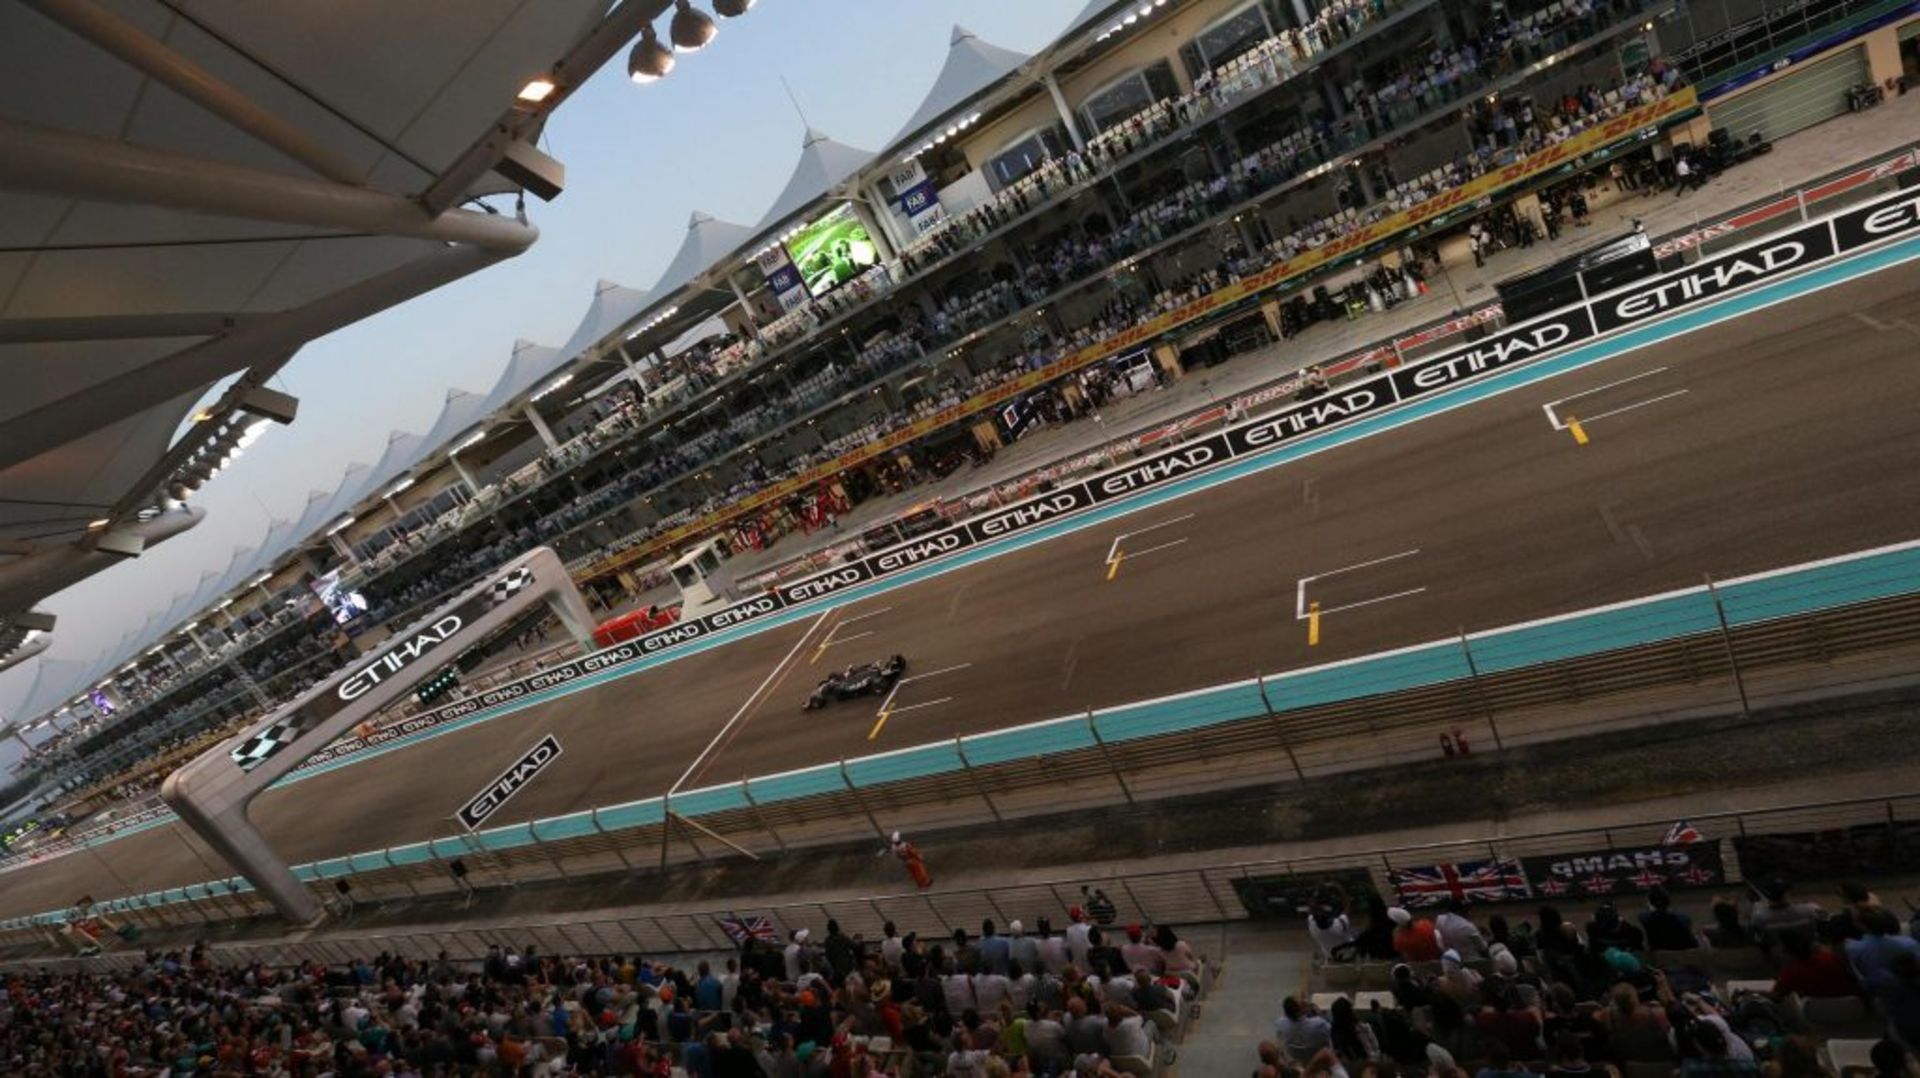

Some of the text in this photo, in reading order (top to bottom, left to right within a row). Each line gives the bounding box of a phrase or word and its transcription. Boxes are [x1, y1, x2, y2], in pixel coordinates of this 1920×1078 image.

[1601, 97, 1682, 140] DHL
[1501, 147, 1569, 184] DHL
[904, 192, 926, 209] FAB
[1407, 190, 1468, 222] DHL
[1322, 227, 1374, 258] DHL
[1241, 265, 1293, 292] DHL
[1616, 241, 1805, 318] ETIHAD
[1170, 295, 1219, 323] DHL
[1103, 326, 1149, 353] DHL
[1413, 322, 1570, 388] ETIHAD
[1244, 390, 1375, 446] ETIHAD
[1102, 446, 1214, 494] ETIHAD
[981, 493, 1077, 534] ETIHAD
[878, 533, 960, 570] ETIHAD
[788, 568, 860, 601] ETIHAD
[711, 598, 774, 628] ETIHAD
[644, 624, 699, 650] ETIHAD
[338, 615, 462, 701] ETIHAD
[584, 647, 633, 671] ETIHAD
[531, 667, 575, 689] ETIHAD
[441, 700, 477, 719] ETIHAD
[484, 685, 525, 704] ETIHAD
[469, 745, 552, 819] ETIHAD
